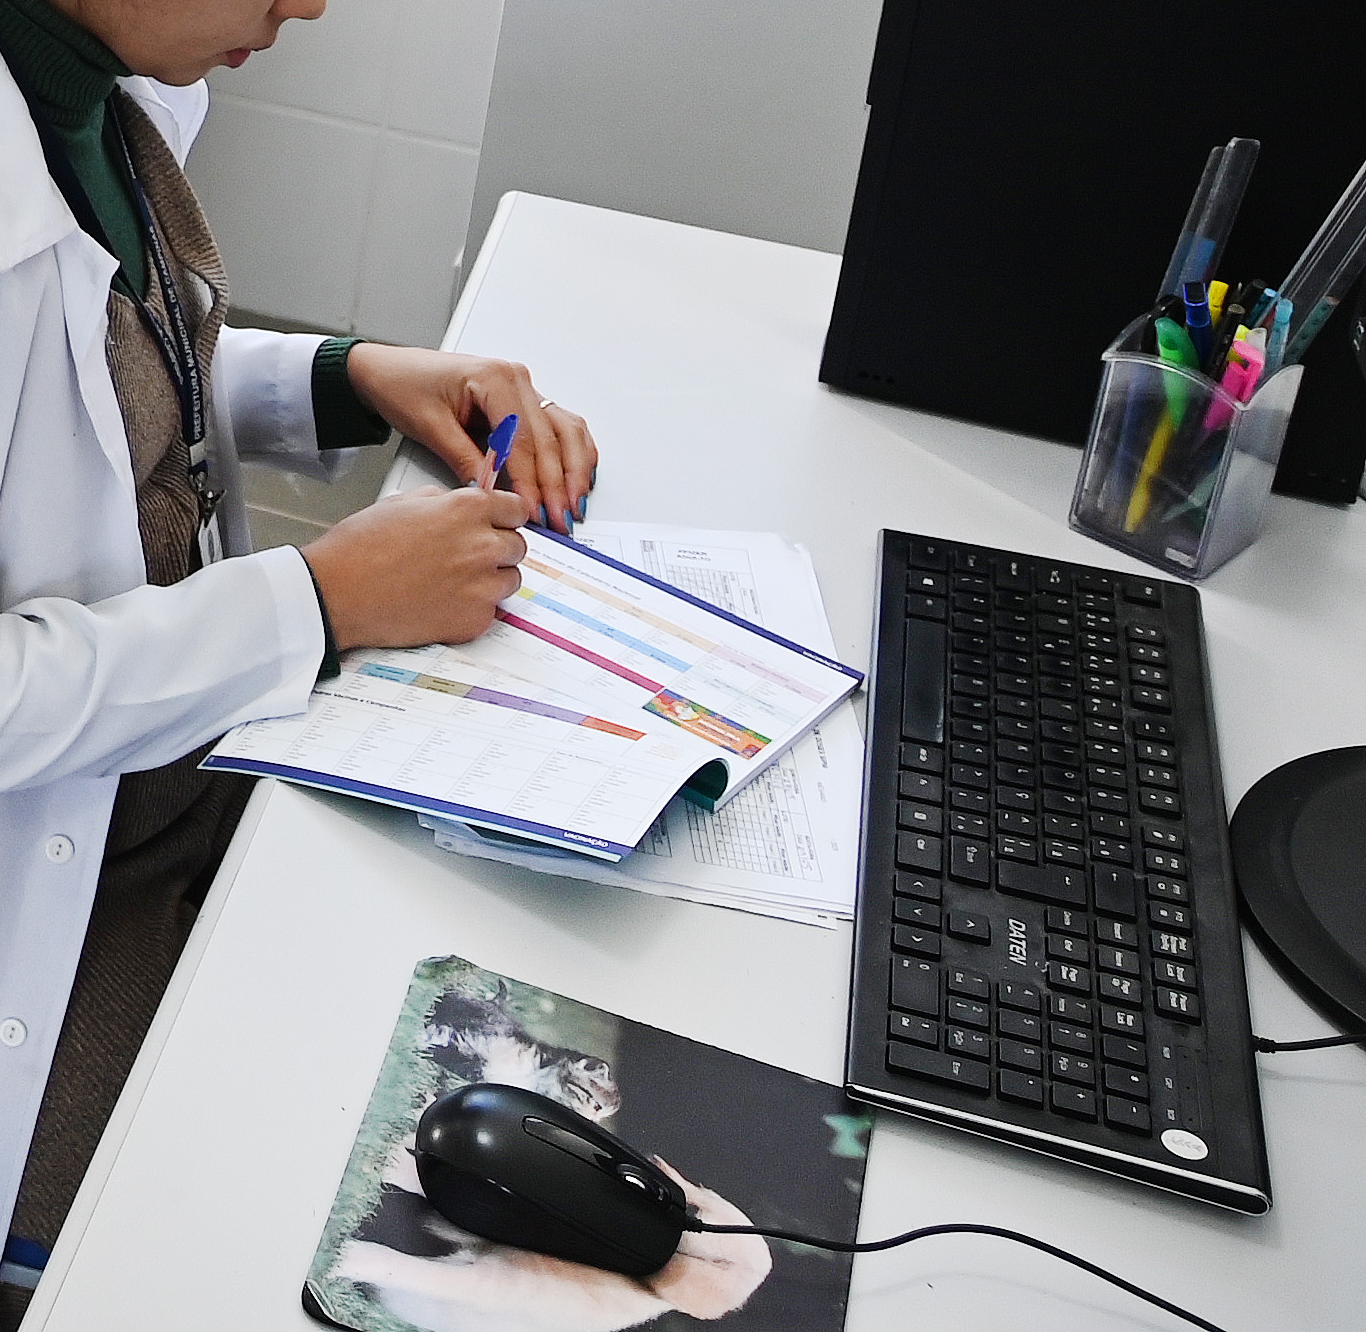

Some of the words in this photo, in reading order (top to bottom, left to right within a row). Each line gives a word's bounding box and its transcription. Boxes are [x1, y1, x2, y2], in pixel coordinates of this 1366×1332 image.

[1008, 918, 1027, 967] DATEN
[1023, 1018, 1035, 1026] 5
[1075, 1031, 1087, 1039] 8
